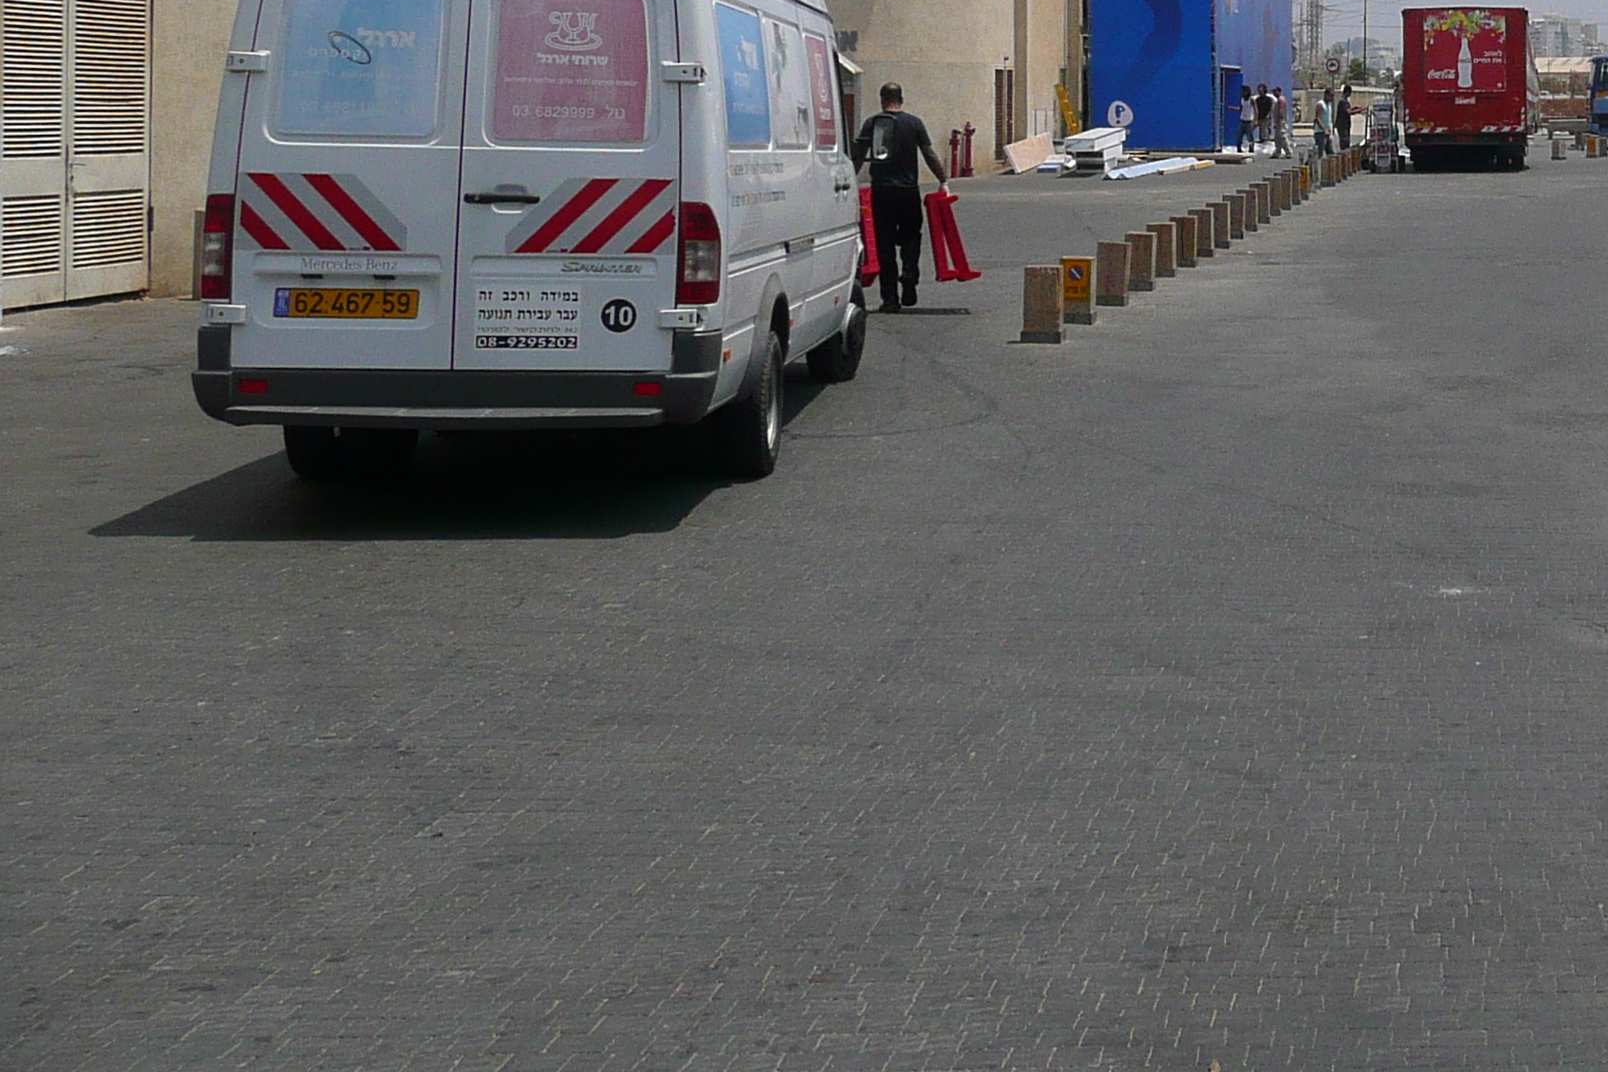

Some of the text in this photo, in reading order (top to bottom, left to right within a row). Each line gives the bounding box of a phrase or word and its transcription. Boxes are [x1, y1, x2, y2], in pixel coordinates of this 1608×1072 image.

[356, 27, 417, 49] ארגל
[511, 105, 529, 117] 03
[535, 106, 596, 119] 6829999
[478, 290, 579, 302] במידה ורכב זה
[478, 308, 578, 320] עבר עבירת תנועה
[604, 305, 633, 326] 10
[477, 336, 577, 348] 08-9295202
